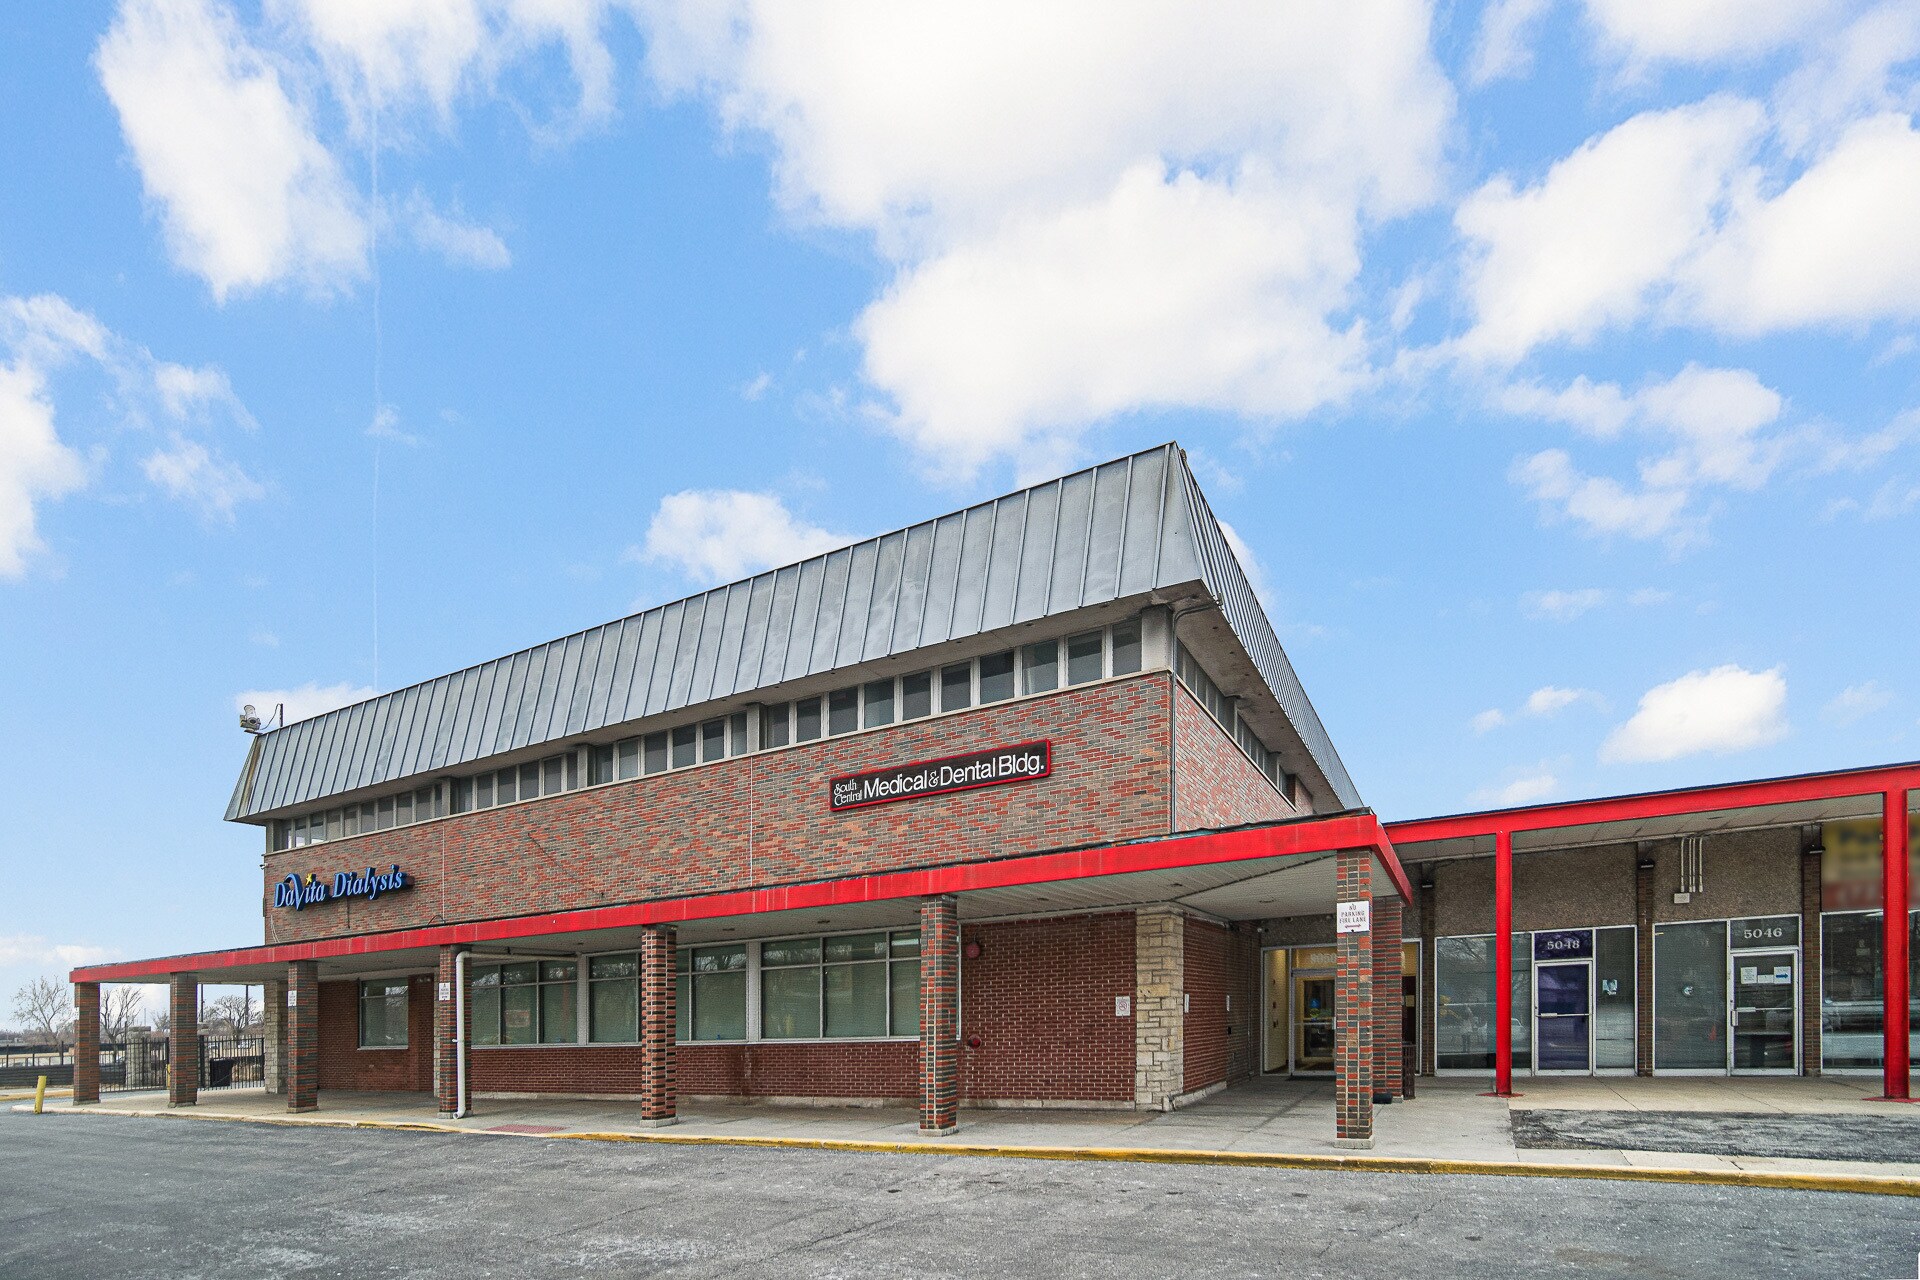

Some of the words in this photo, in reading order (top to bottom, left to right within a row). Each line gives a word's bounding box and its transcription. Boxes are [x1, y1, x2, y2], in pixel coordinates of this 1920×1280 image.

[864, 770, 928, 799] Medical
[940, 758, 996, 786] Dental
[999, 753, 1045, 777] Bldg.
[834, 779, 857, 795] South
[834, 790, 862, 805] Central
[273, 873, 327, 911] DaVita
[332, 864, 403, 900] Dialysis
[1744, 928, 1782, 938] 5046
[1547, 940, 1580, 950] 5048
